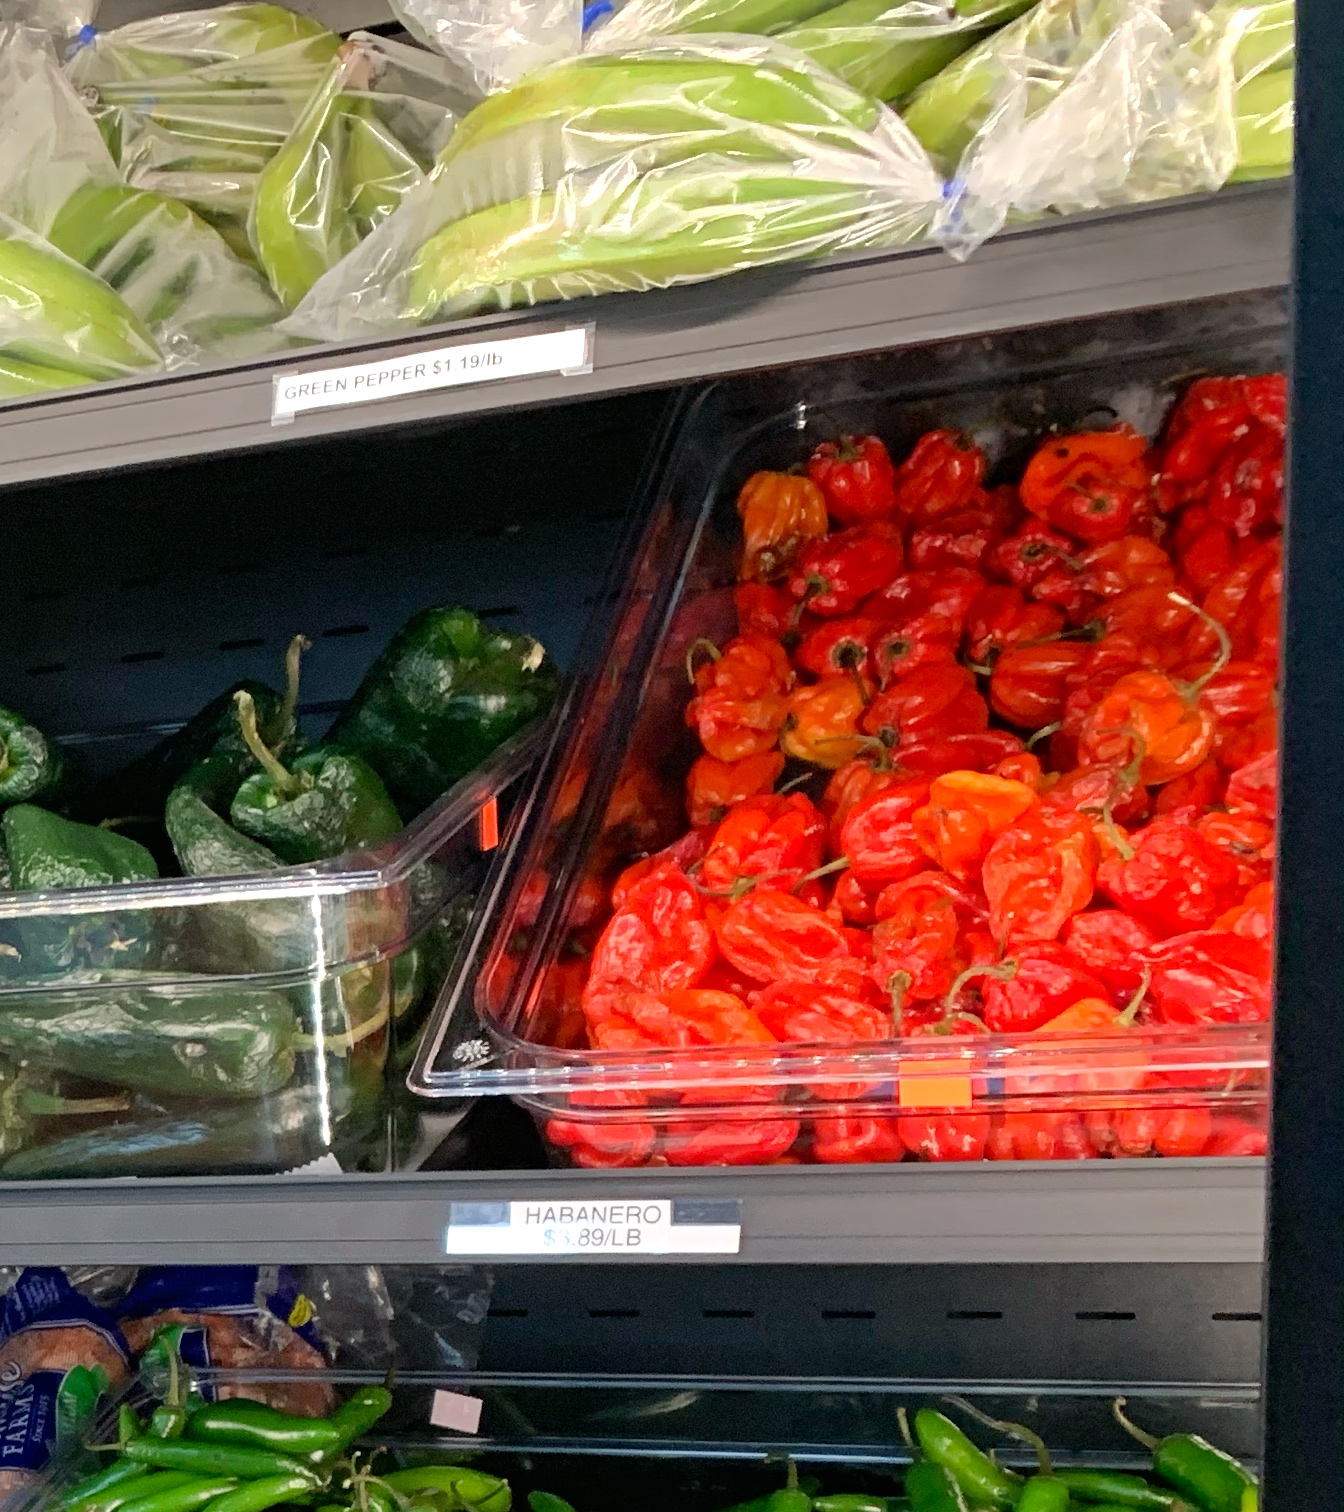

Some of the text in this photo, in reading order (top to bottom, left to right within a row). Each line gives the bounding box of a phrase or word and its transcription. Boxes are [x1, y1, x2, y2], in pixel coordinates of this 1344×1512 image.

[284, 352, 503, 400] GREEN PEPPER $1.19/lb
[525, 1205, 662, 1225] HABANERO
[2, 1383, 34, 1458] FARMS
